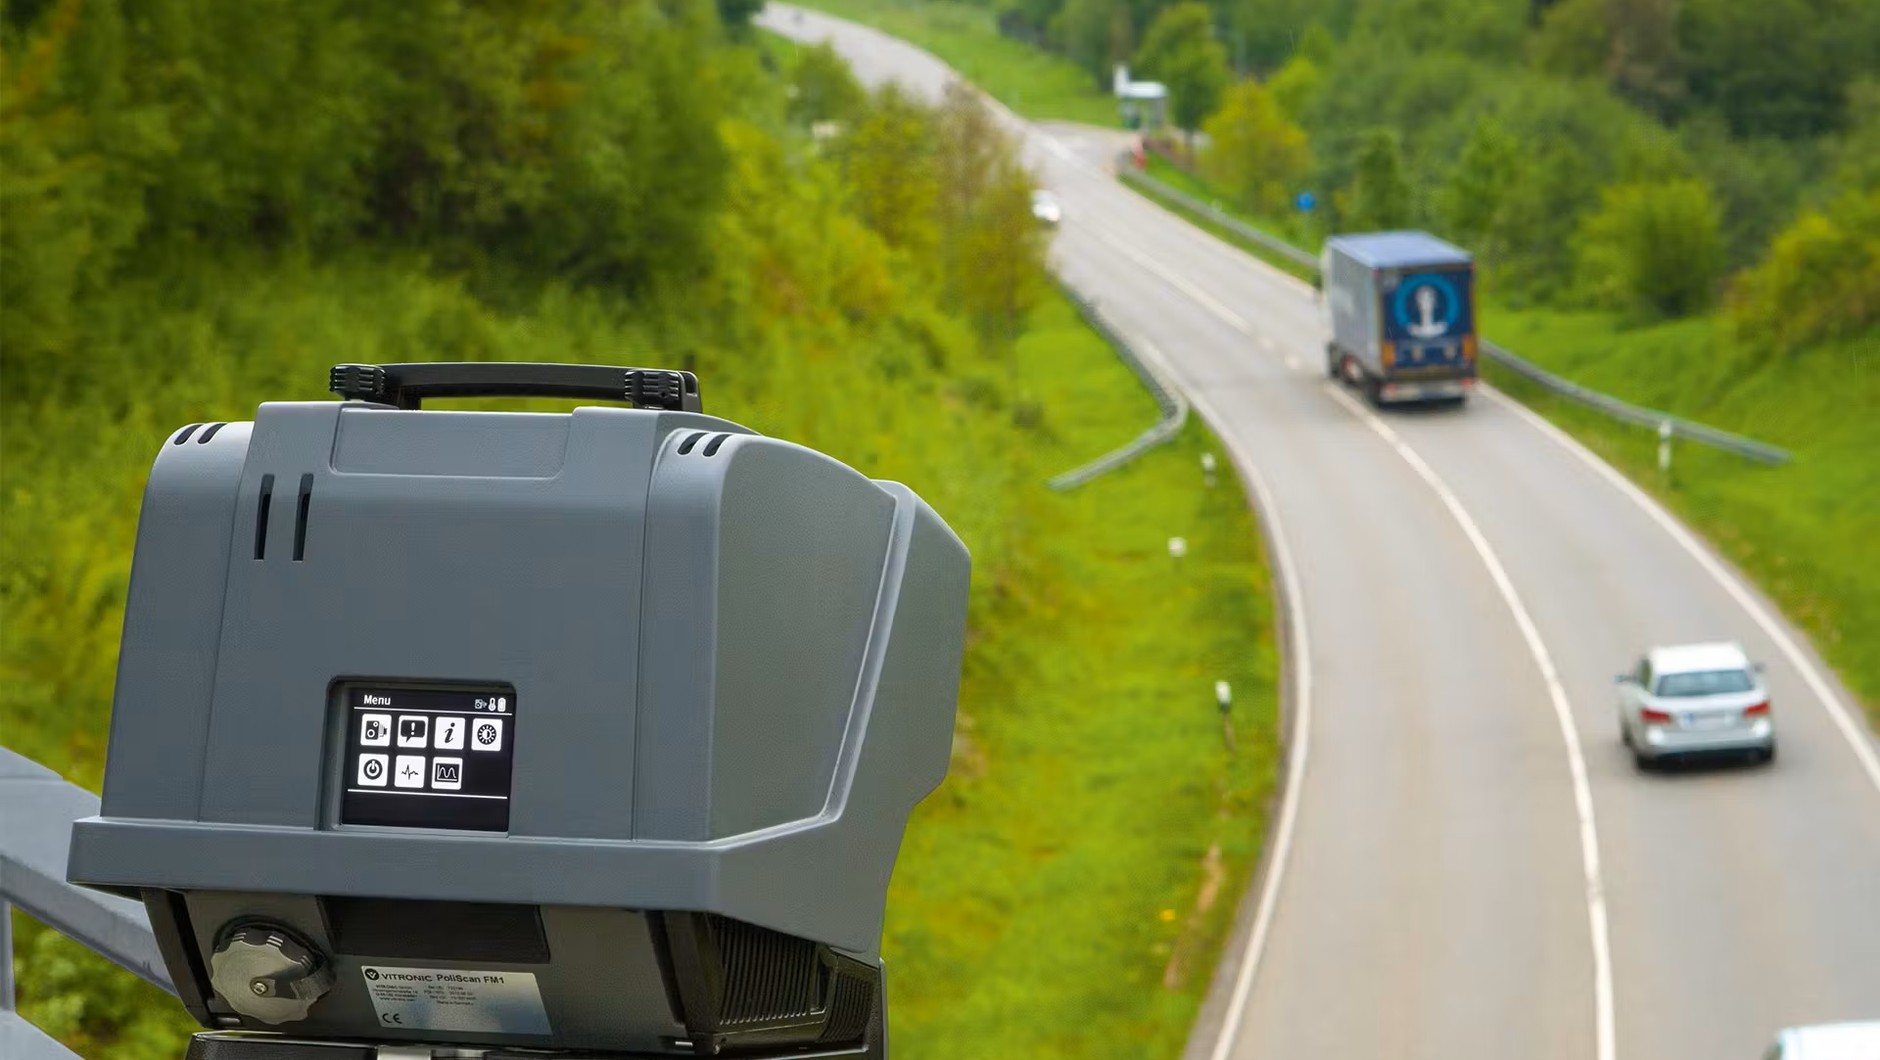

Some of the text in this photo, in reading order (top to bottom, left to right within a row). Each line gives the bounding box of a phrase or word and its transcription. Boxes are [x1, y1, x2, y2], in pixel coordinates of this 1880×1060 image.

[364, 694, 391, 705] Menu
[381, 973, 505, 984] VITRONIC PoliScan FM1
[382, 1013, 402, 1024] CE
